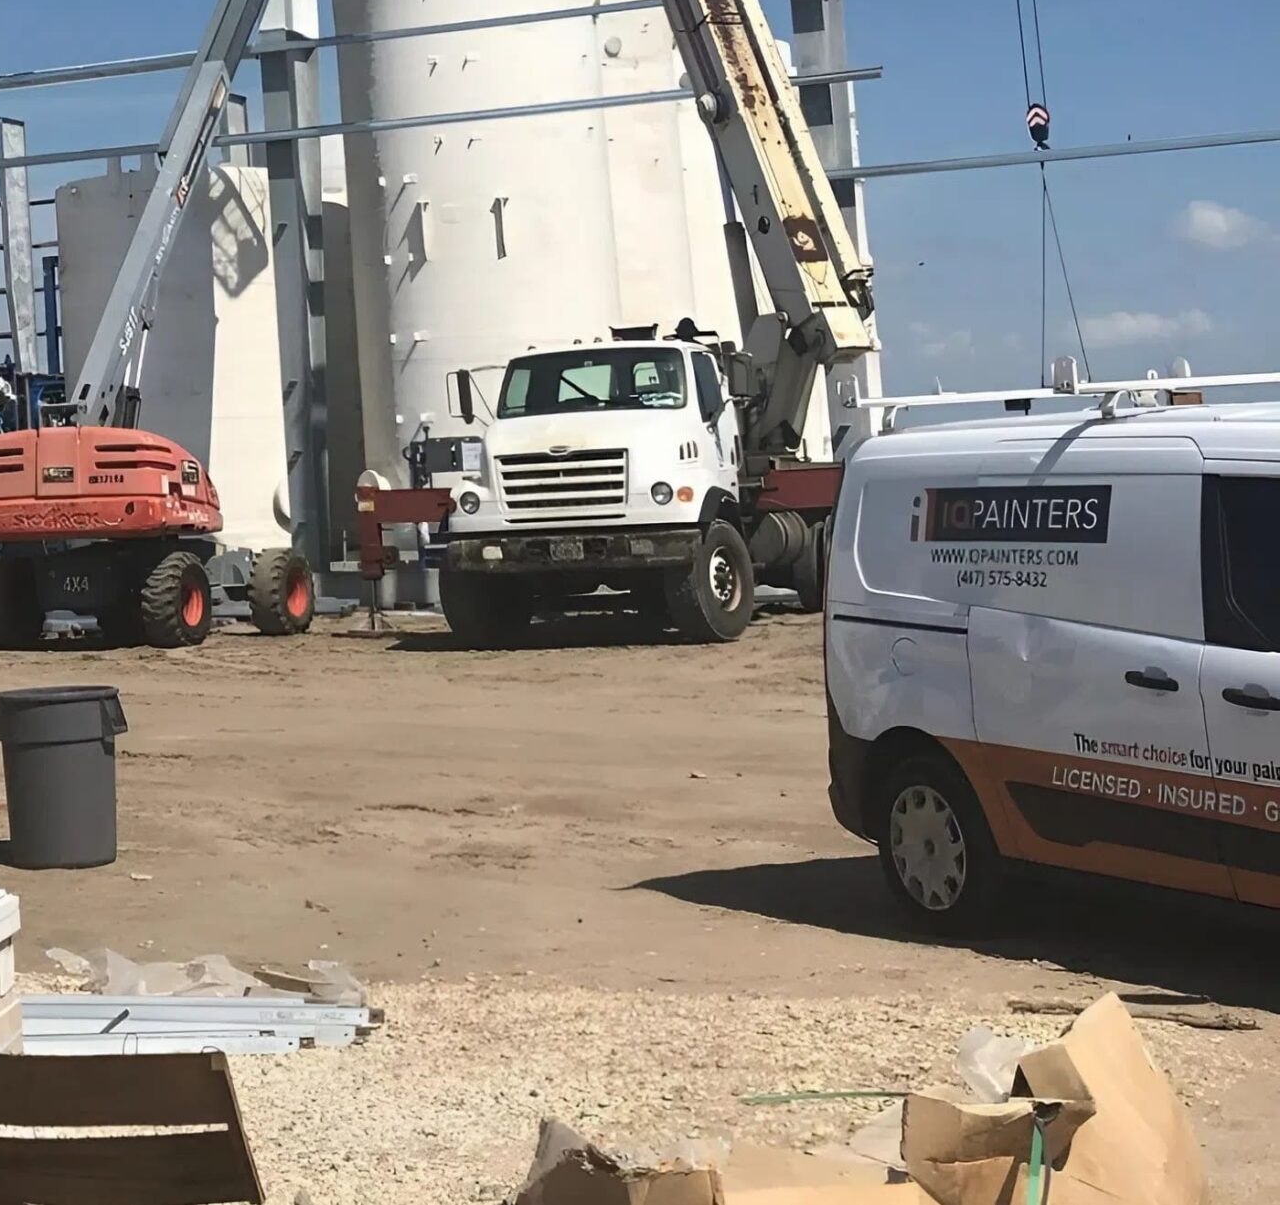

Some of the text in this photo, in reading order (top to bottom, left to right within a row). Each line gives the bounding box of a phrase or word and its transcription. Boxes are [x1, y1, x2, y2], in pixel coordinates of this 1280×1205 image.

[988, 571, 1048, 588] 575-8432
[1073, 732, 1098, 754] The
[1101, 741, 1140, 759] smart
[1142, 744, 1187, 767] choice
[1189, 749, 1212, 770] for
[1215, 757, 1247, 776] your
[1051, 765, 1141, 799] LICENSED
[1158, 783, 1246, 816] INSURED
